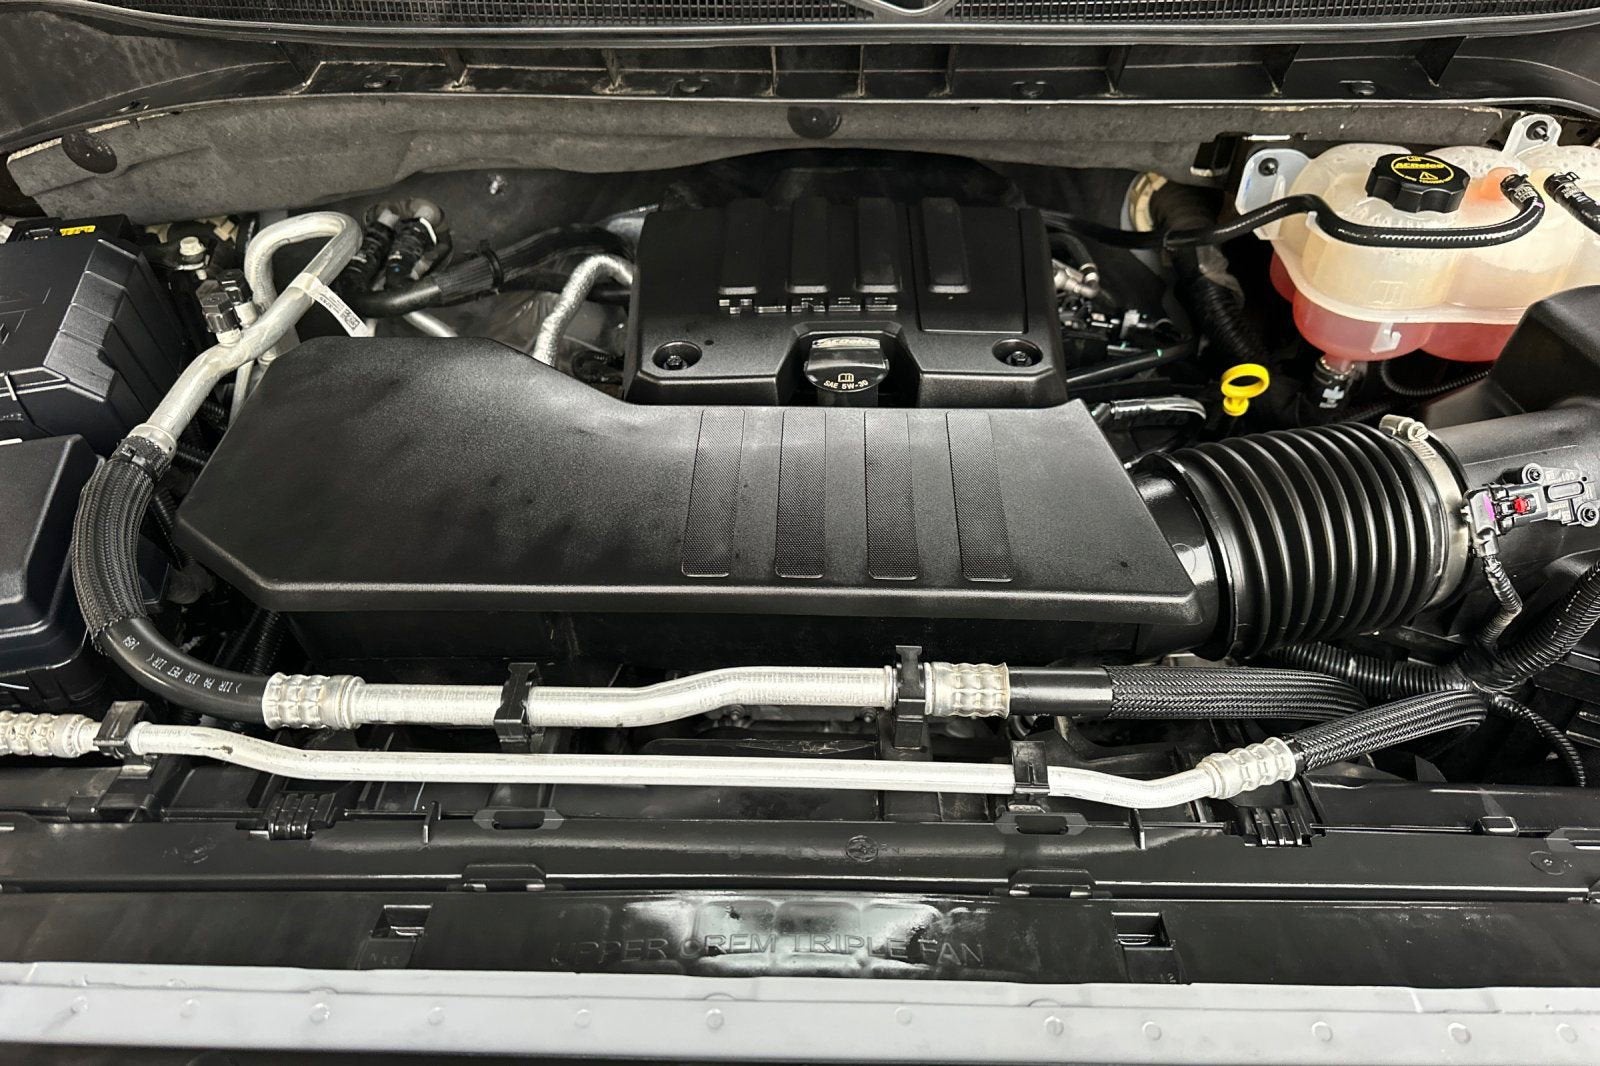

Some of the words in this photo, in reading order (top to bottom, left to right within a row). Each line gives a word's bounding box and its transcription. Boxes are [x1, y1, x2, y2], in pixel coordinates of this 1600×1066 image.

[823, 380, 839, 389] SAE
[841, 379, 869, 390] 5W-30
[792, 933, 909, 959] TRIPLE
[917, 939, 985, 967] FAN
